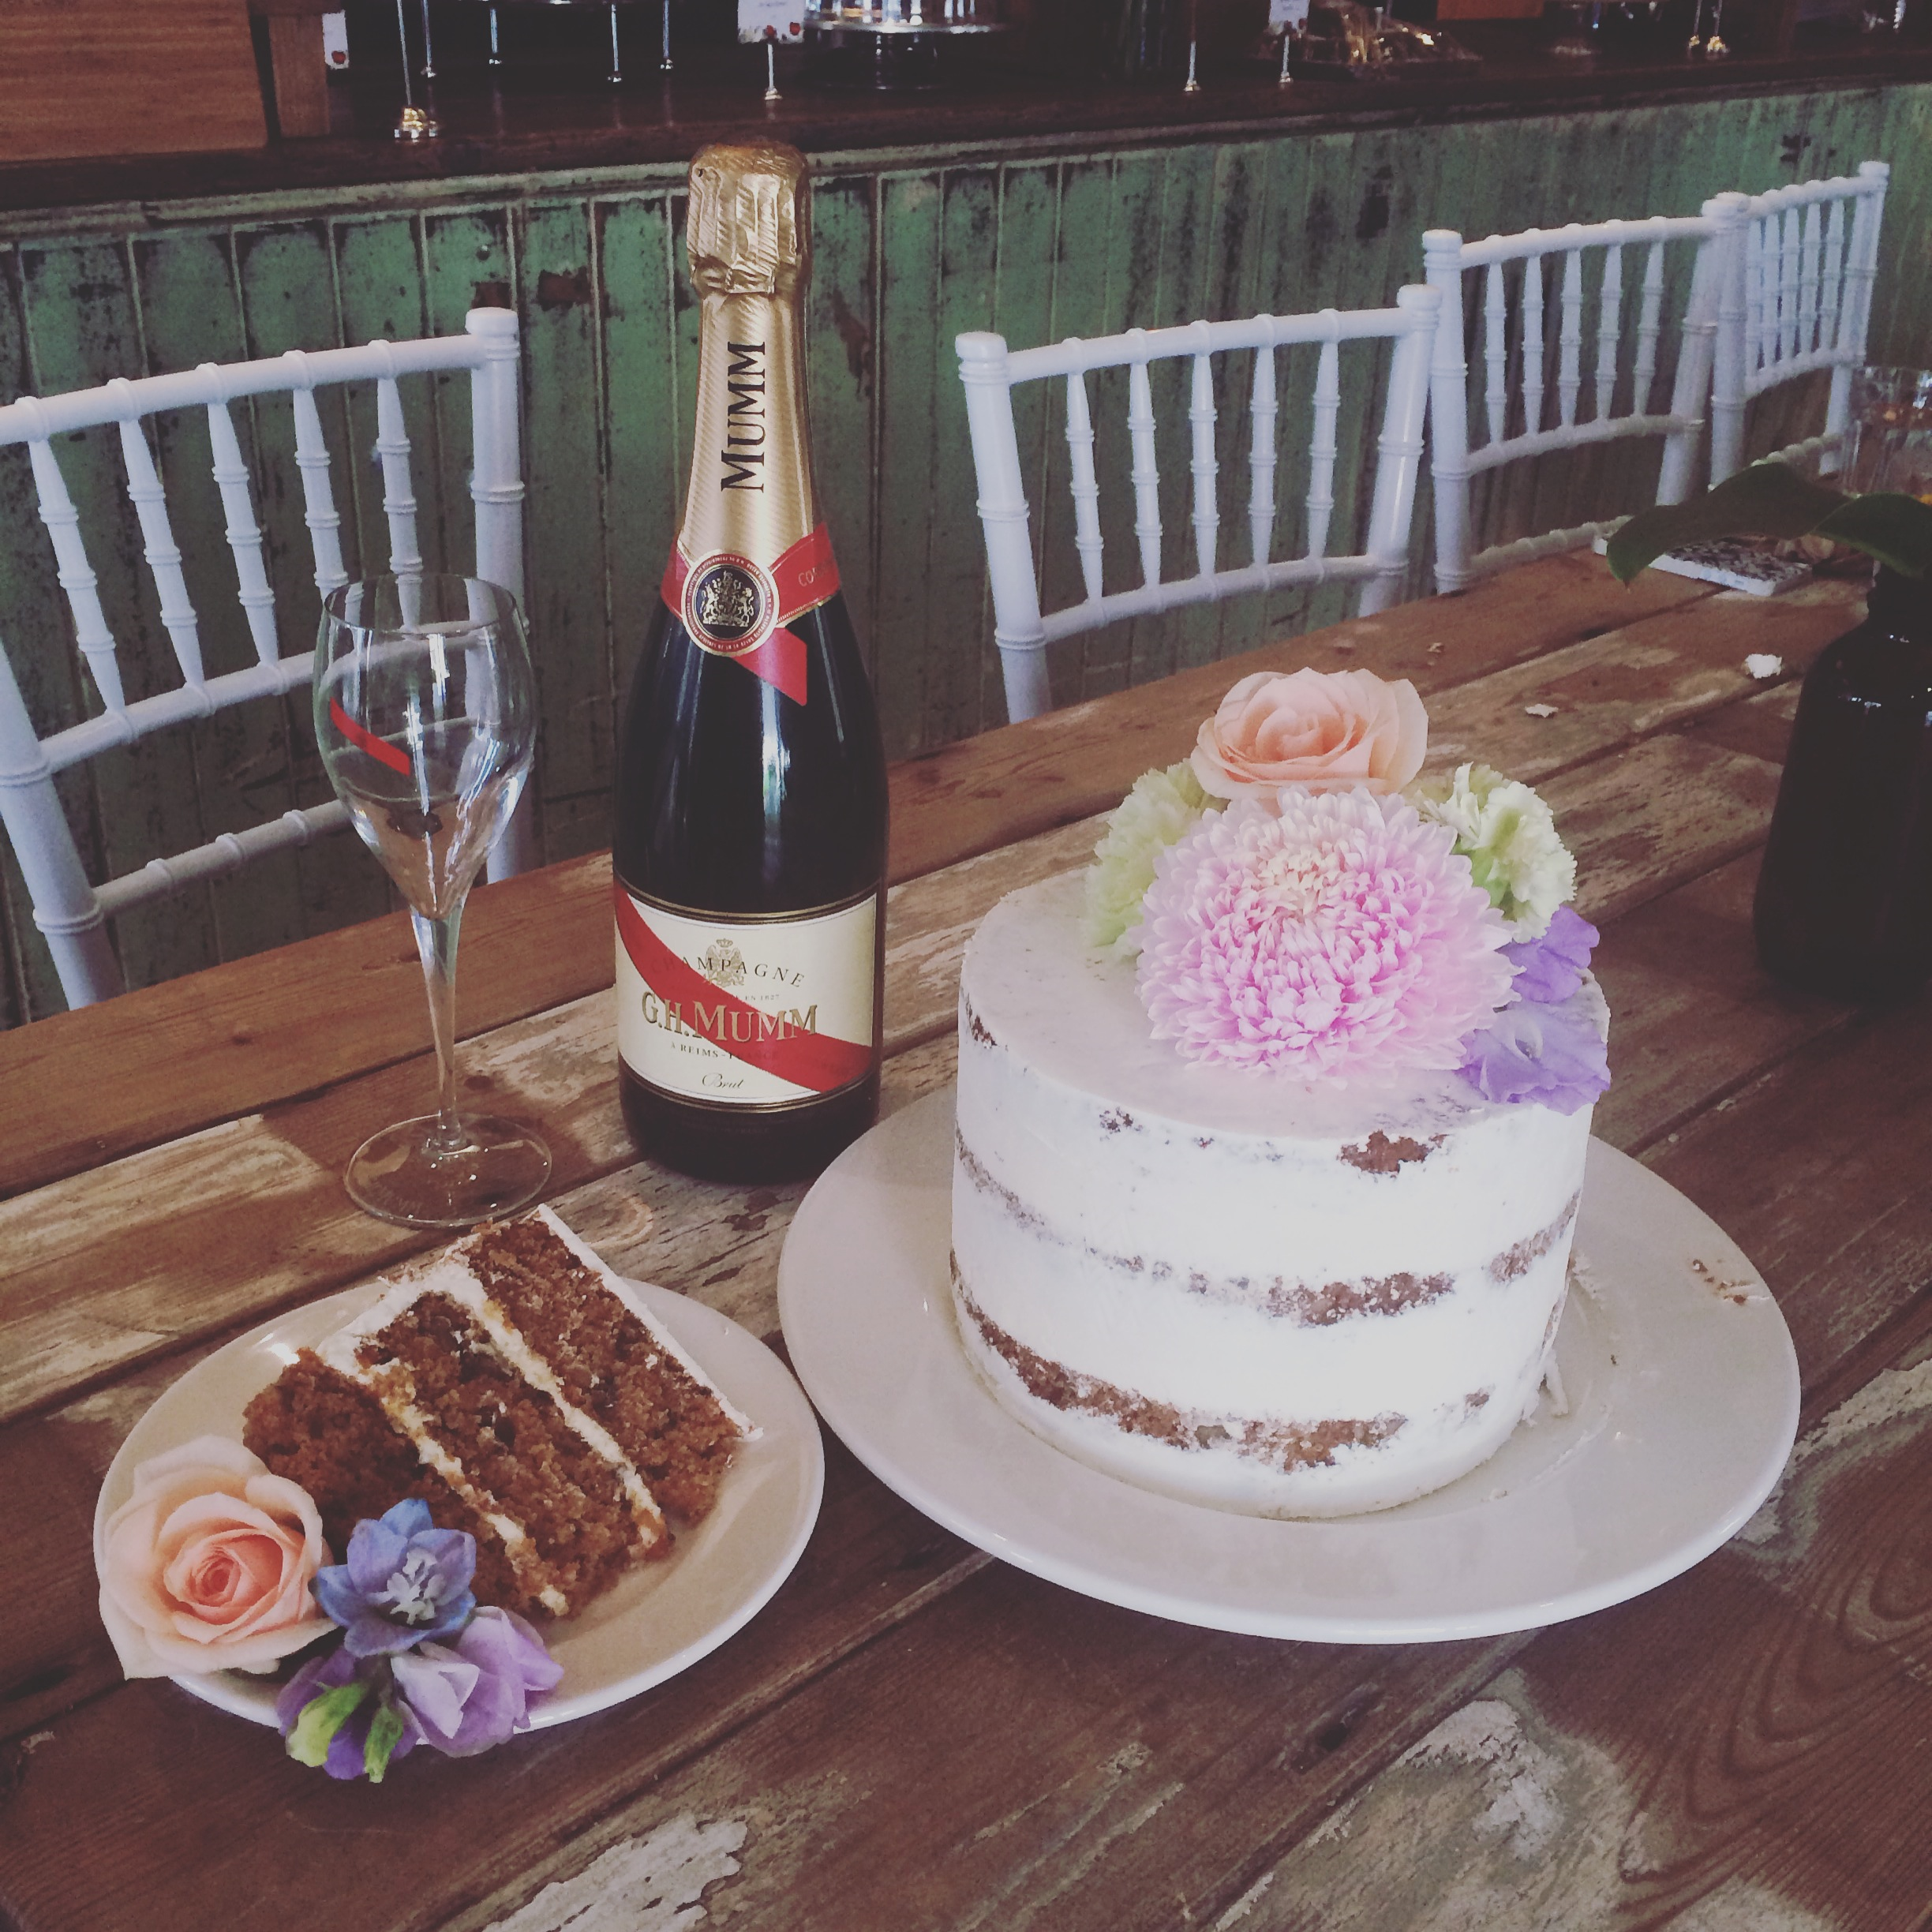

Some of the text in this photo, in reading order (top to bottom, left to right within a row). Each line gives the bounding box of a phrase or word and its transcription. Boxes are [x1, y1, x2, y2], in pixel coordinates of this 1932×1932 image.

[721, 341, 766, 493] MUMM
[680, 1044, 719, 1058] REIMS
[702, 1073, 744, 1089] Brut
